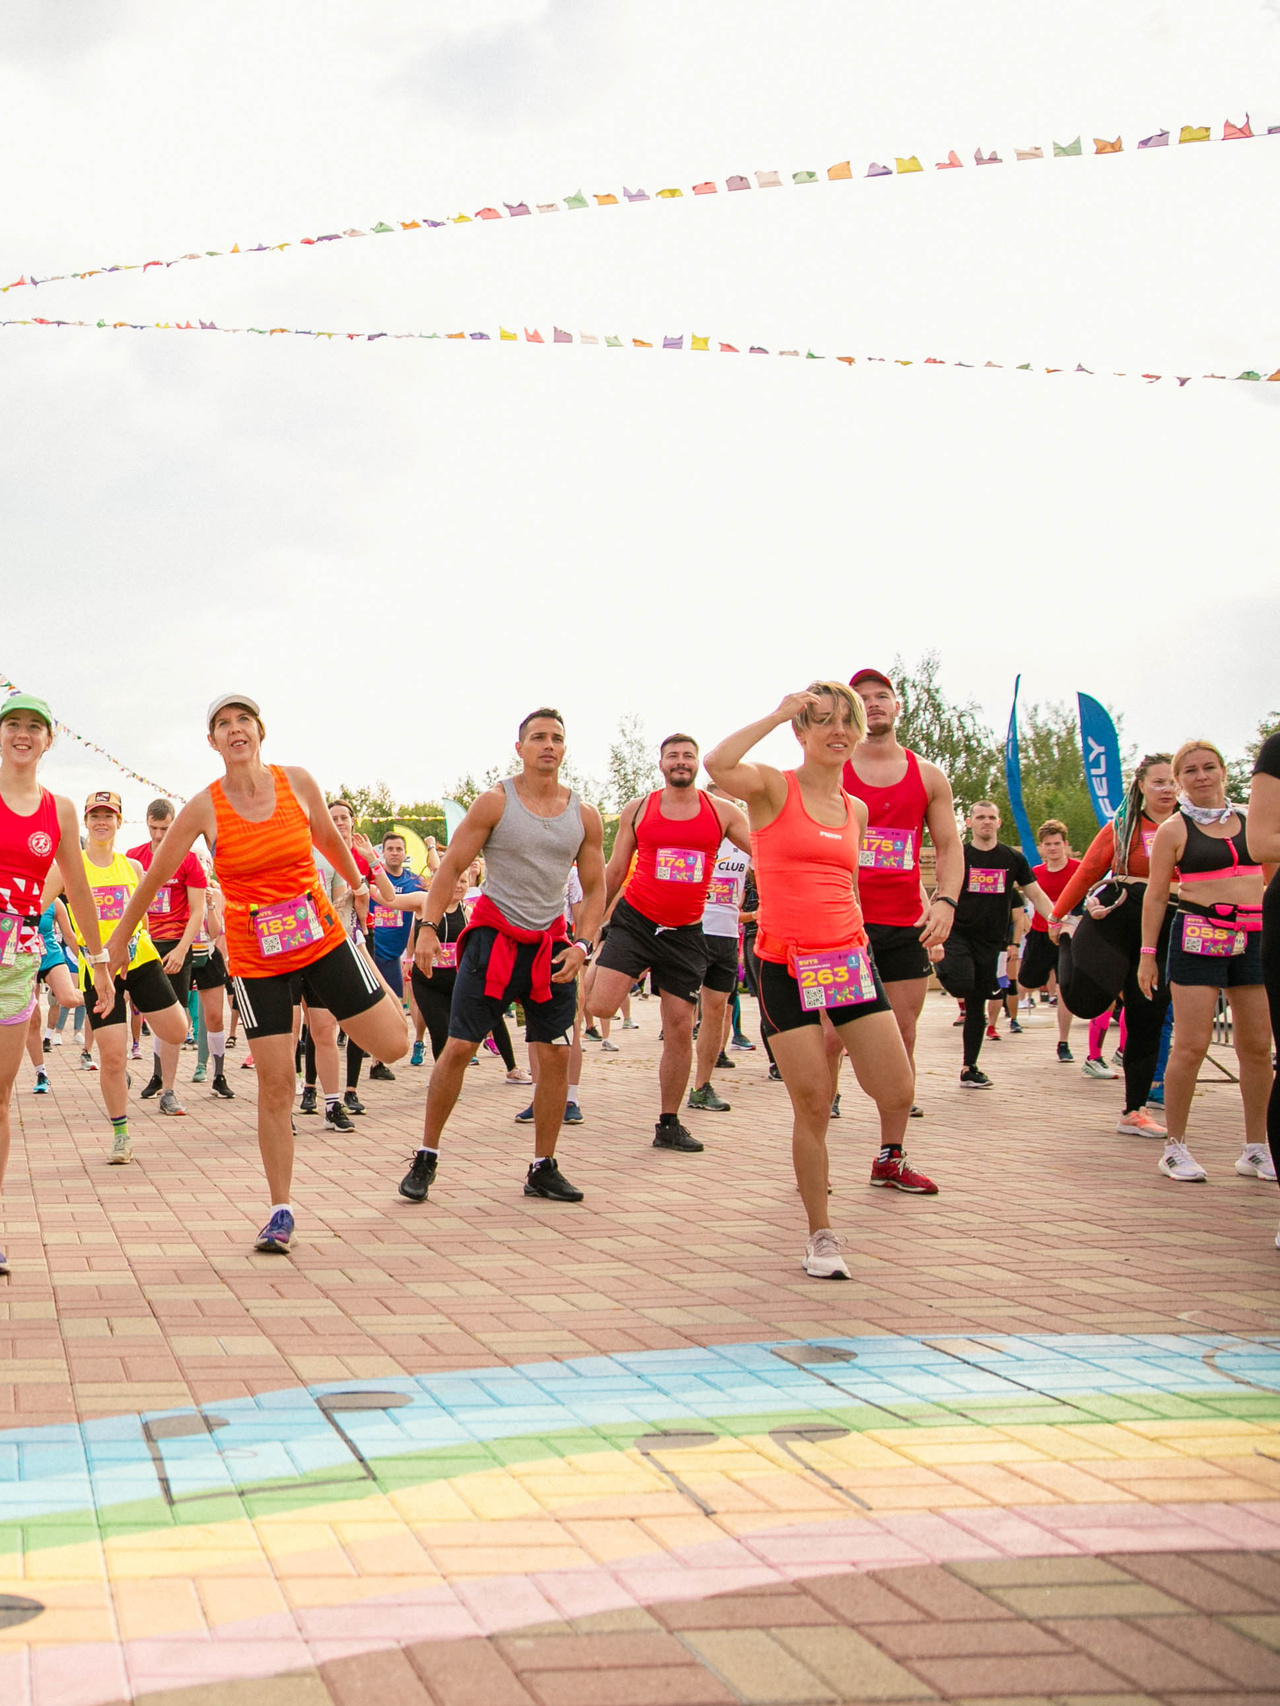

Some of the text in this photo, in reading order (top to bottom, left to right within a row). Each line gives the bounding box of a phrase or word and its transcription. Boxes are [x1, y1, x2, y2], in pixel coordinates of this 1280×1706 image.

[1087, 735, 1115, 823] FELY
[862, 838, 893, 852] 175
[659, 857, 686, 868] 174
[718, 861, 746, 872] CLUB
[971, 875, 994, 883] 206
[258, 914, 297, 936] 183
[1186, 926, 1228, 940] 058
[801, 966, 849, 988] 263
